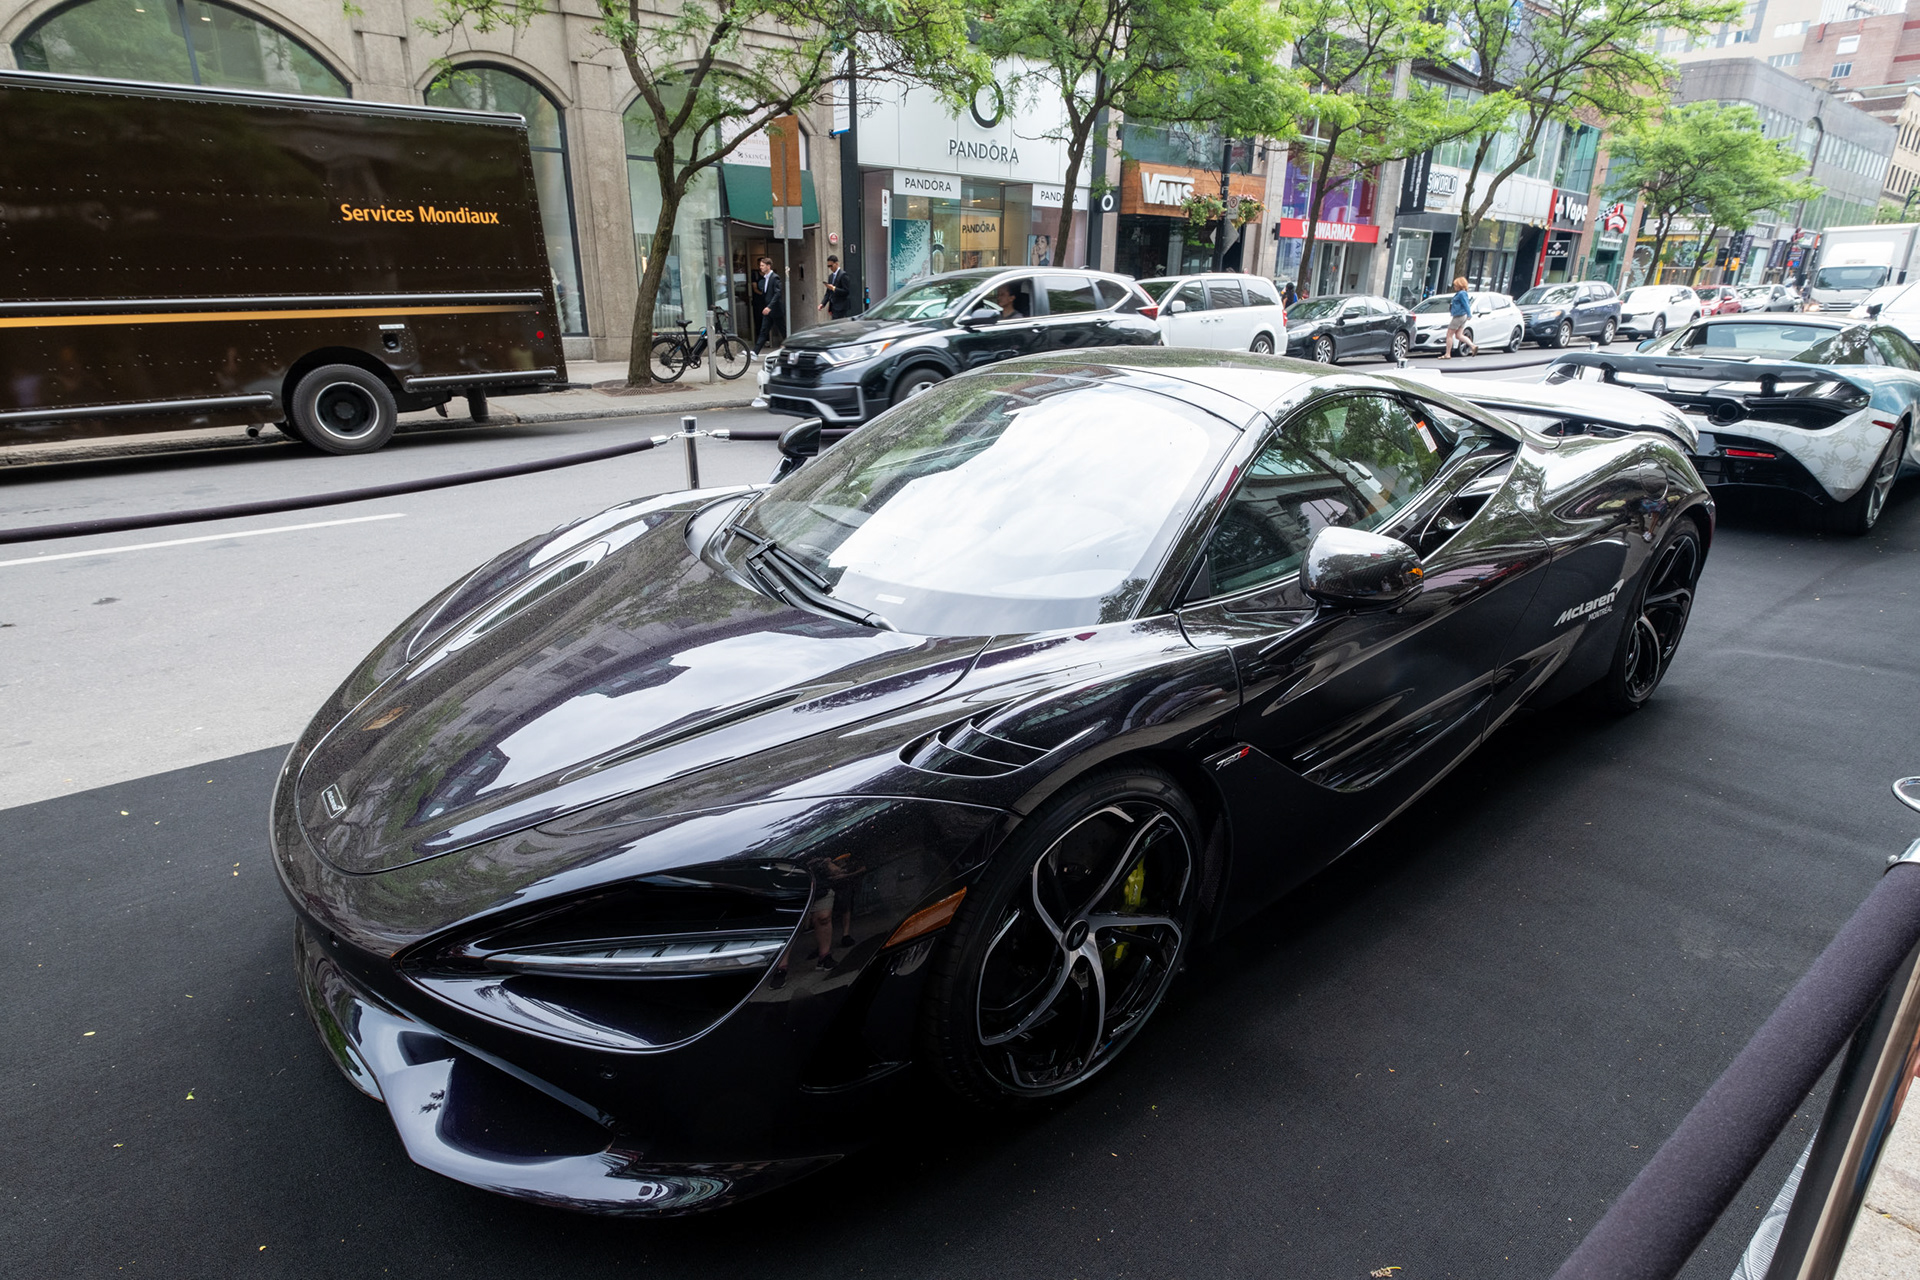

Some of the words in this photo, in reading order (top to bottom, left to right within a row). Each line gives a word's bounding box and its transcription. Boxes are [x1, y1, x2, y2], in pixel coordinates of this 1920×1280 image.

[949, 139, 1019, 163] PANDORA
[904, 177, 952, 192] PANDORA
[1140, 172, 1195, 206] VANS
[340, 203, 415, 222] Services
[418, 205, 500, 224] Mondiaux
[1565, 196, 1588, 226] Vape
[961, 221, 996, 234] PANDORA
[1301, 221, 1357, 240] SAWARMAZ
[1553, 591, 1617, 627] McLaren
